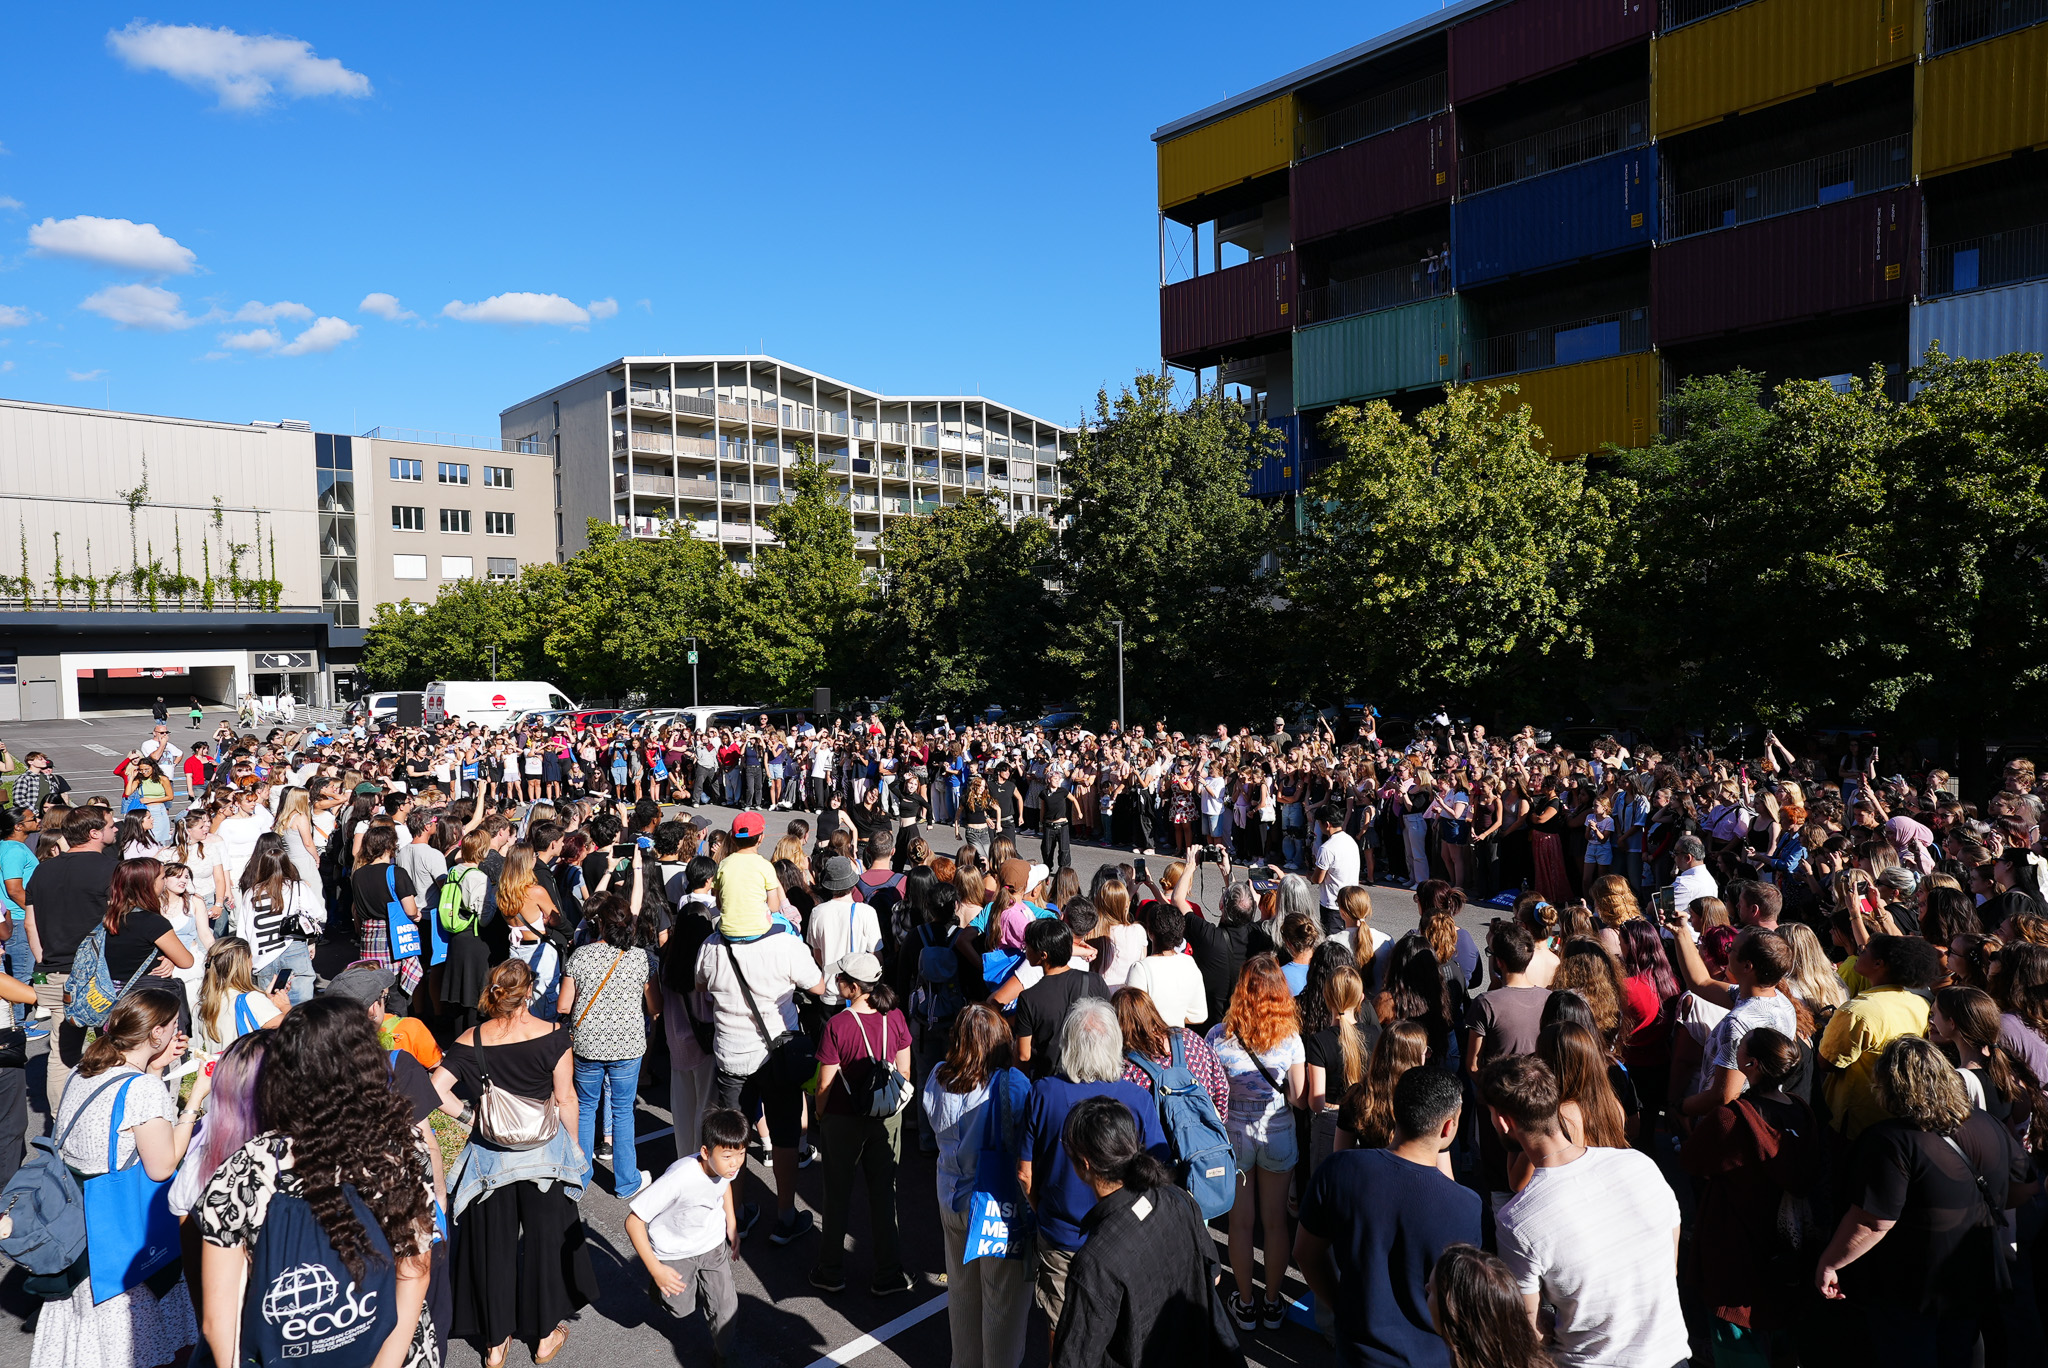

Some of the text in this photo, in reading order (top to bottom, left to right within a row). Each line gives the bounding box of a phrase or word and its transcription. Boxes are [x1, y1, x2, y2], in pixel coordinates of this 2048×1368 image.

[398, 933, 413, 944] ME
[981, 1220, 1008, 1238] ME
[282, 1281, 378, 1341] ecdc
[311, 1347, 327, 1355] AND
